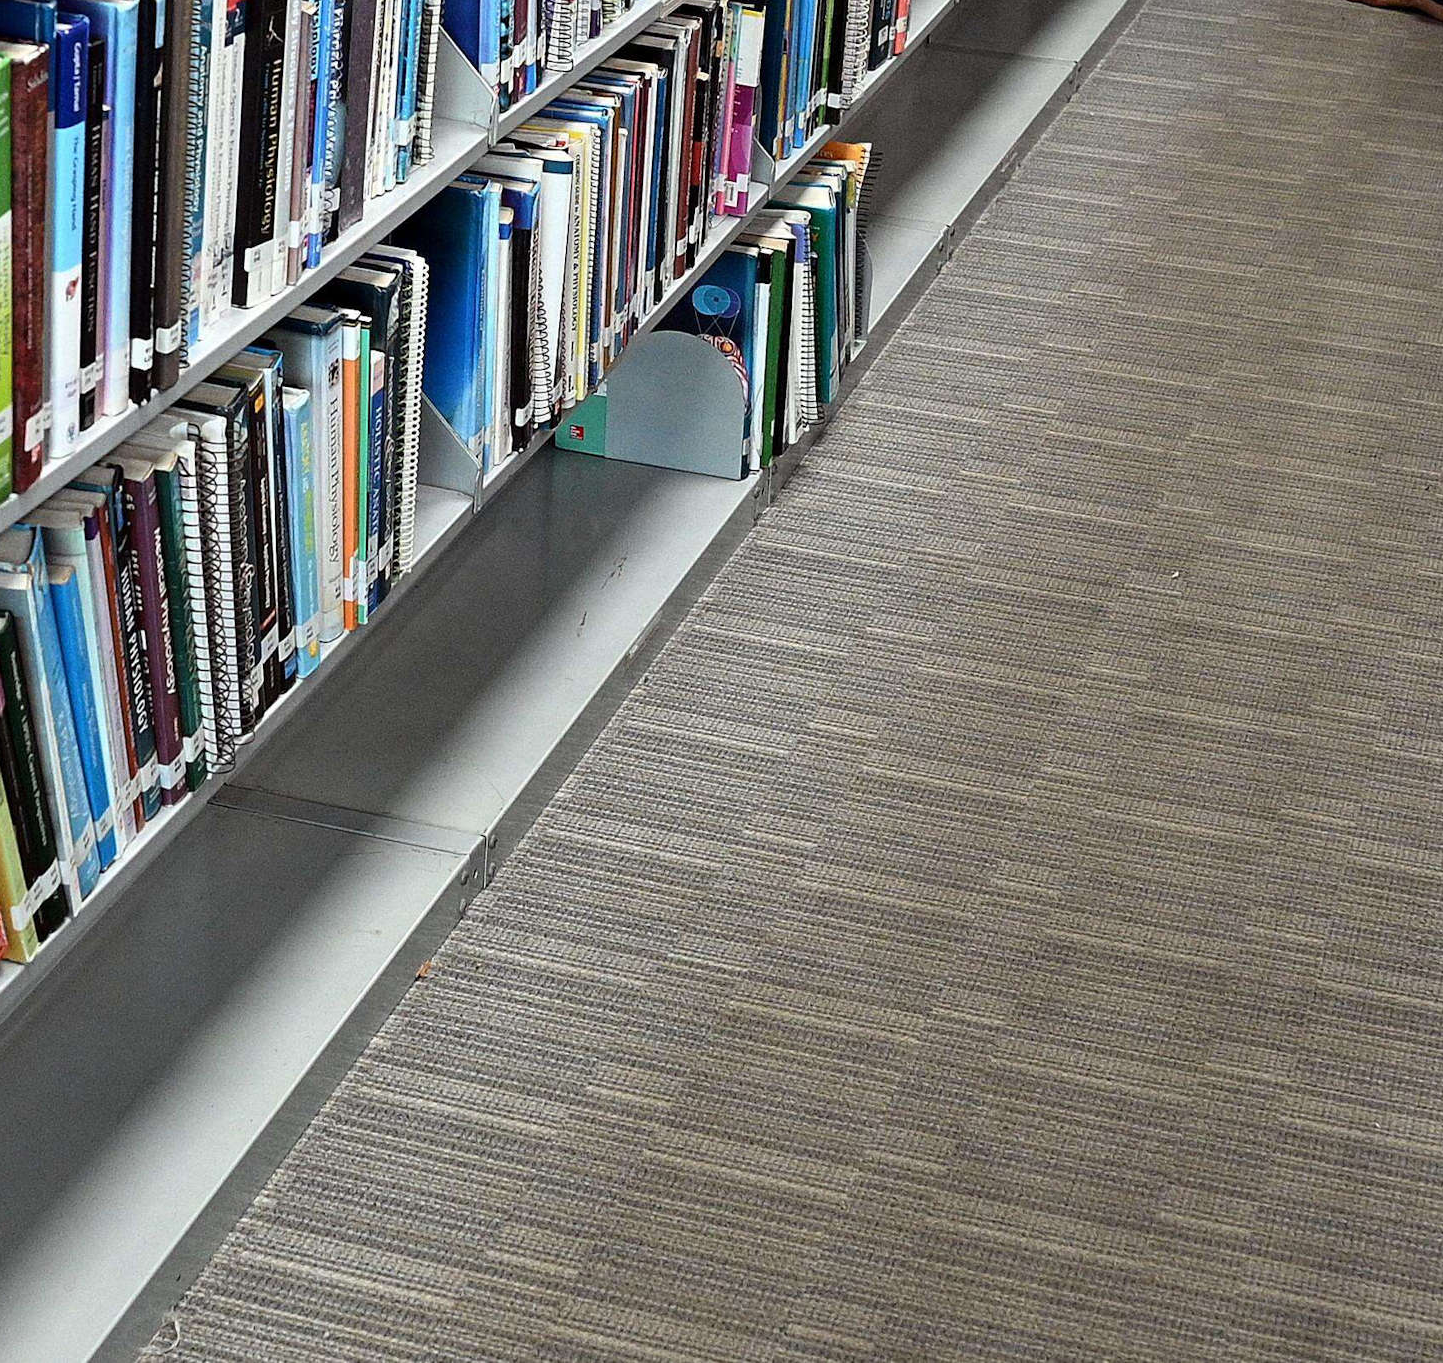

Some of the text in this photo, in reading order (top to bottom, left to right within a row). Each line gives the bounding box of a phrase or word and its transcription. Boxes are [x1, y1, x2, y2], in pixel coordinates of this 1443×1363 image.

[197, 45, 208, 107] Anatomy
[287, 28, 300, 106] Structures
[261, 58, 282, 235] Human Physiology
[282, 121, 296, 193] Functions
[87, 124, 101, 334] HUMAN HAND FUNCTION
[570, 214, 580, 332] ANATOMY PHYSIOLOGY
[2, 248, 11, 356] Human Body
[327, 396, 342, 564] Human Physiology
[373, 405, 383, 483] HOLISTIC
[120, 567, 149, 734] HUMAN PHYSIOLOGY
[153, 526, 177, 695] Medical Physiology
